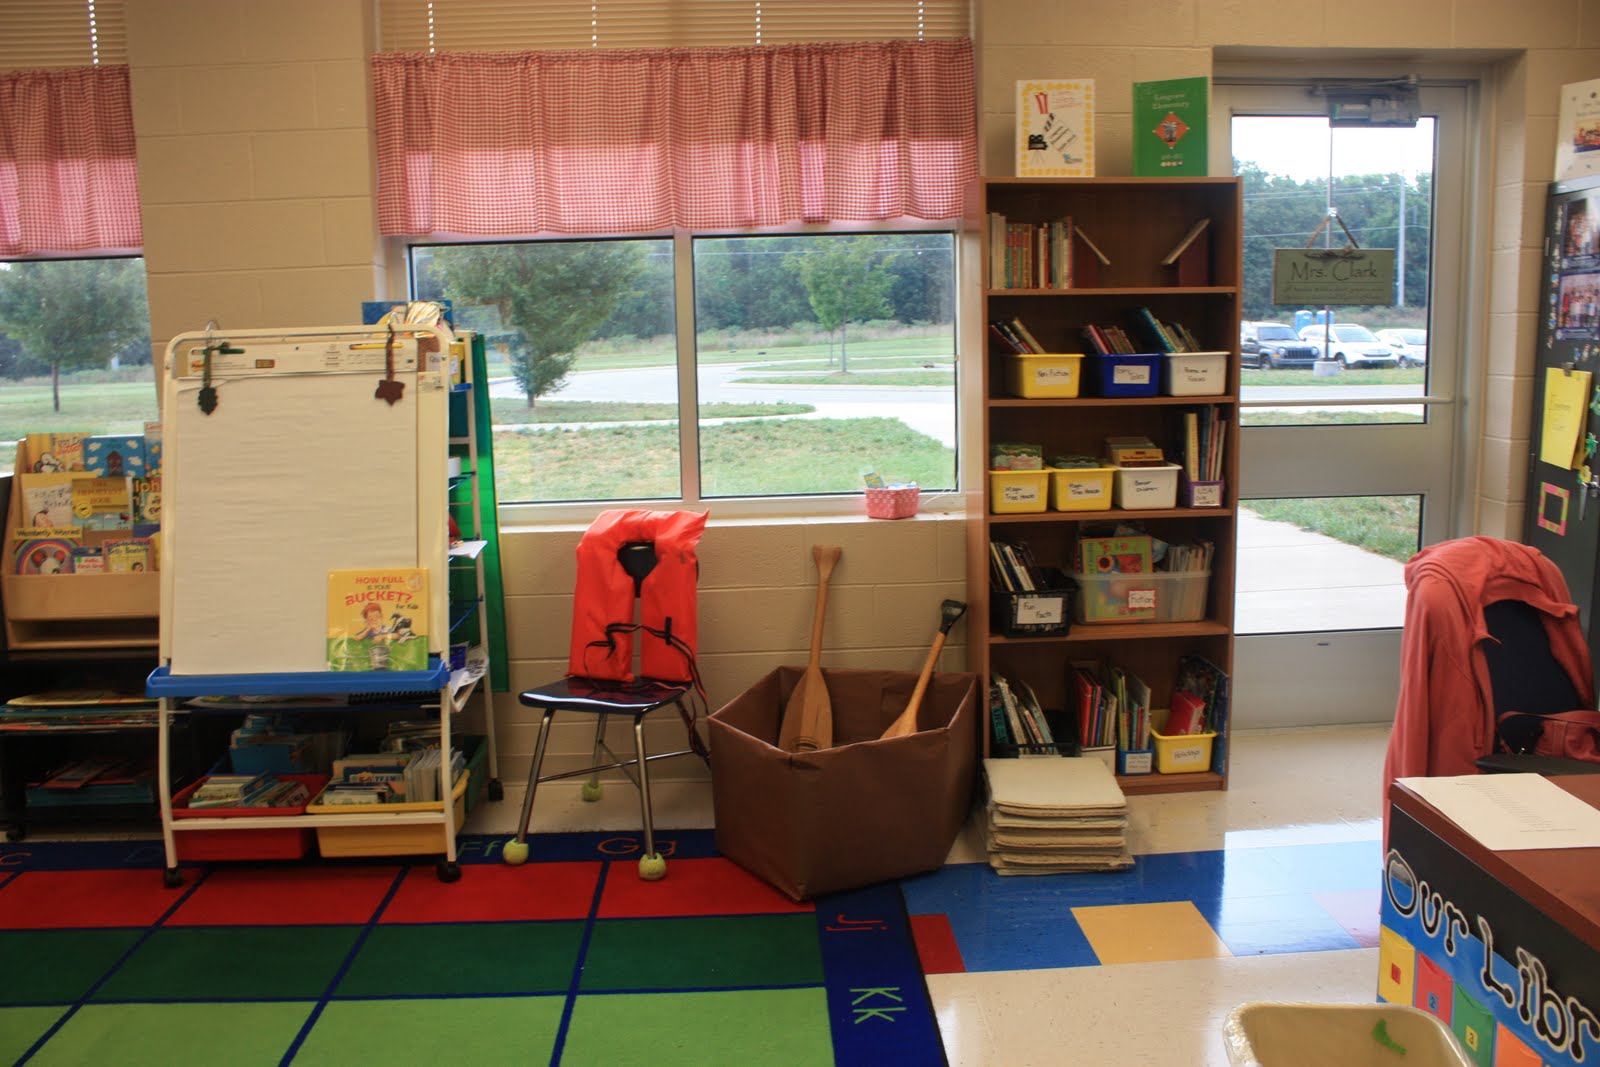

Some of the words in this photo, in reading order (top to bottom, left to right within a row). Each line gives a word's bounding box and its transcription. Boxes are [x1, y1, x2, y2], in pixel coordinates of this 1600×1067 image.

[1290, 261, 1328, 281] Mrs.
[1332, 259, 1377, 282] Clark
[355, 576, 379, 584] HOW
[382, 575, 405, 583] FULL
[345, 591, 413, 606] BUCKET?
[1386, 848, 1469, 957] Our
